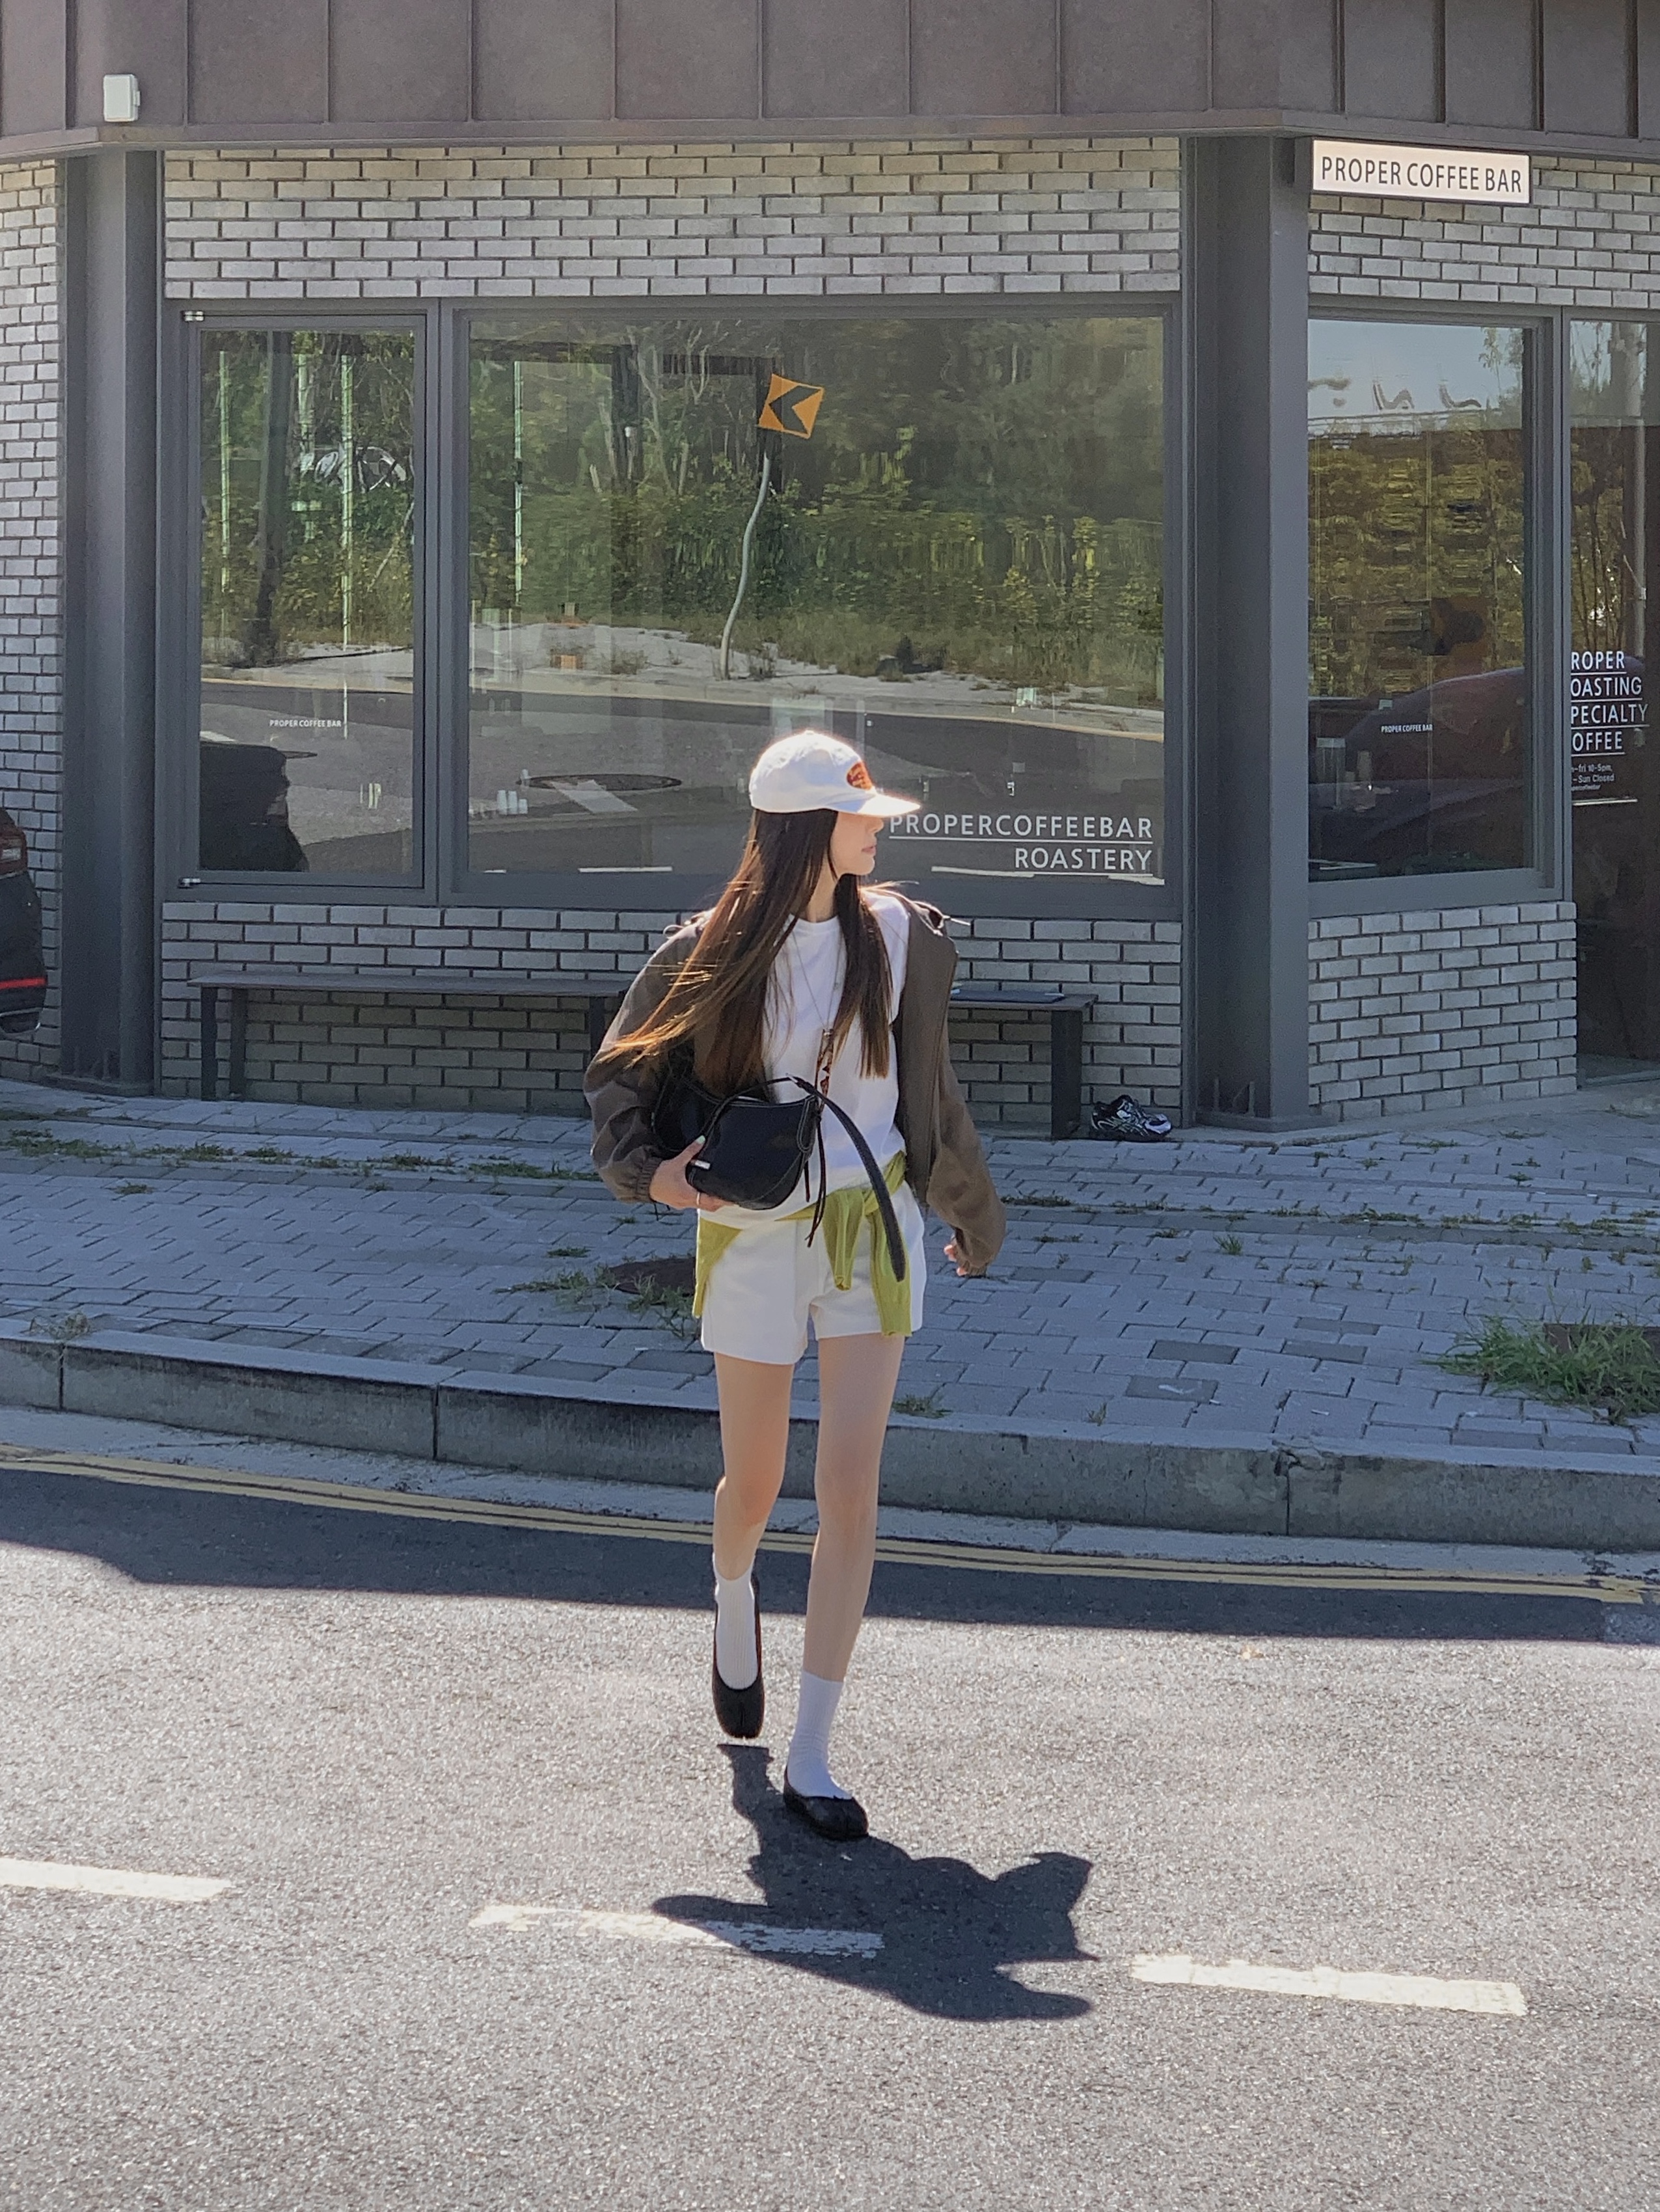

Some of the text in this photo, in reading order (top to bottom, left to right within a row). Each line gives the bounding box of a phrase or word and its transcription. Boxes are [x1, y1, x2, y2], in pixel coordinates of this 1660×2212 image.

[1322, 156, 1522, 193] PROPER COFFEE BAR
[1571, 651, 1625, 670] ROPER
[1571, 677, 1642, 697] OASTING
[1571, 703, 1649, 724] PECIALTY
[1572, 731, 1623, 751] OFFEE
[1014, 847, 1152, 871] ROASTERY
